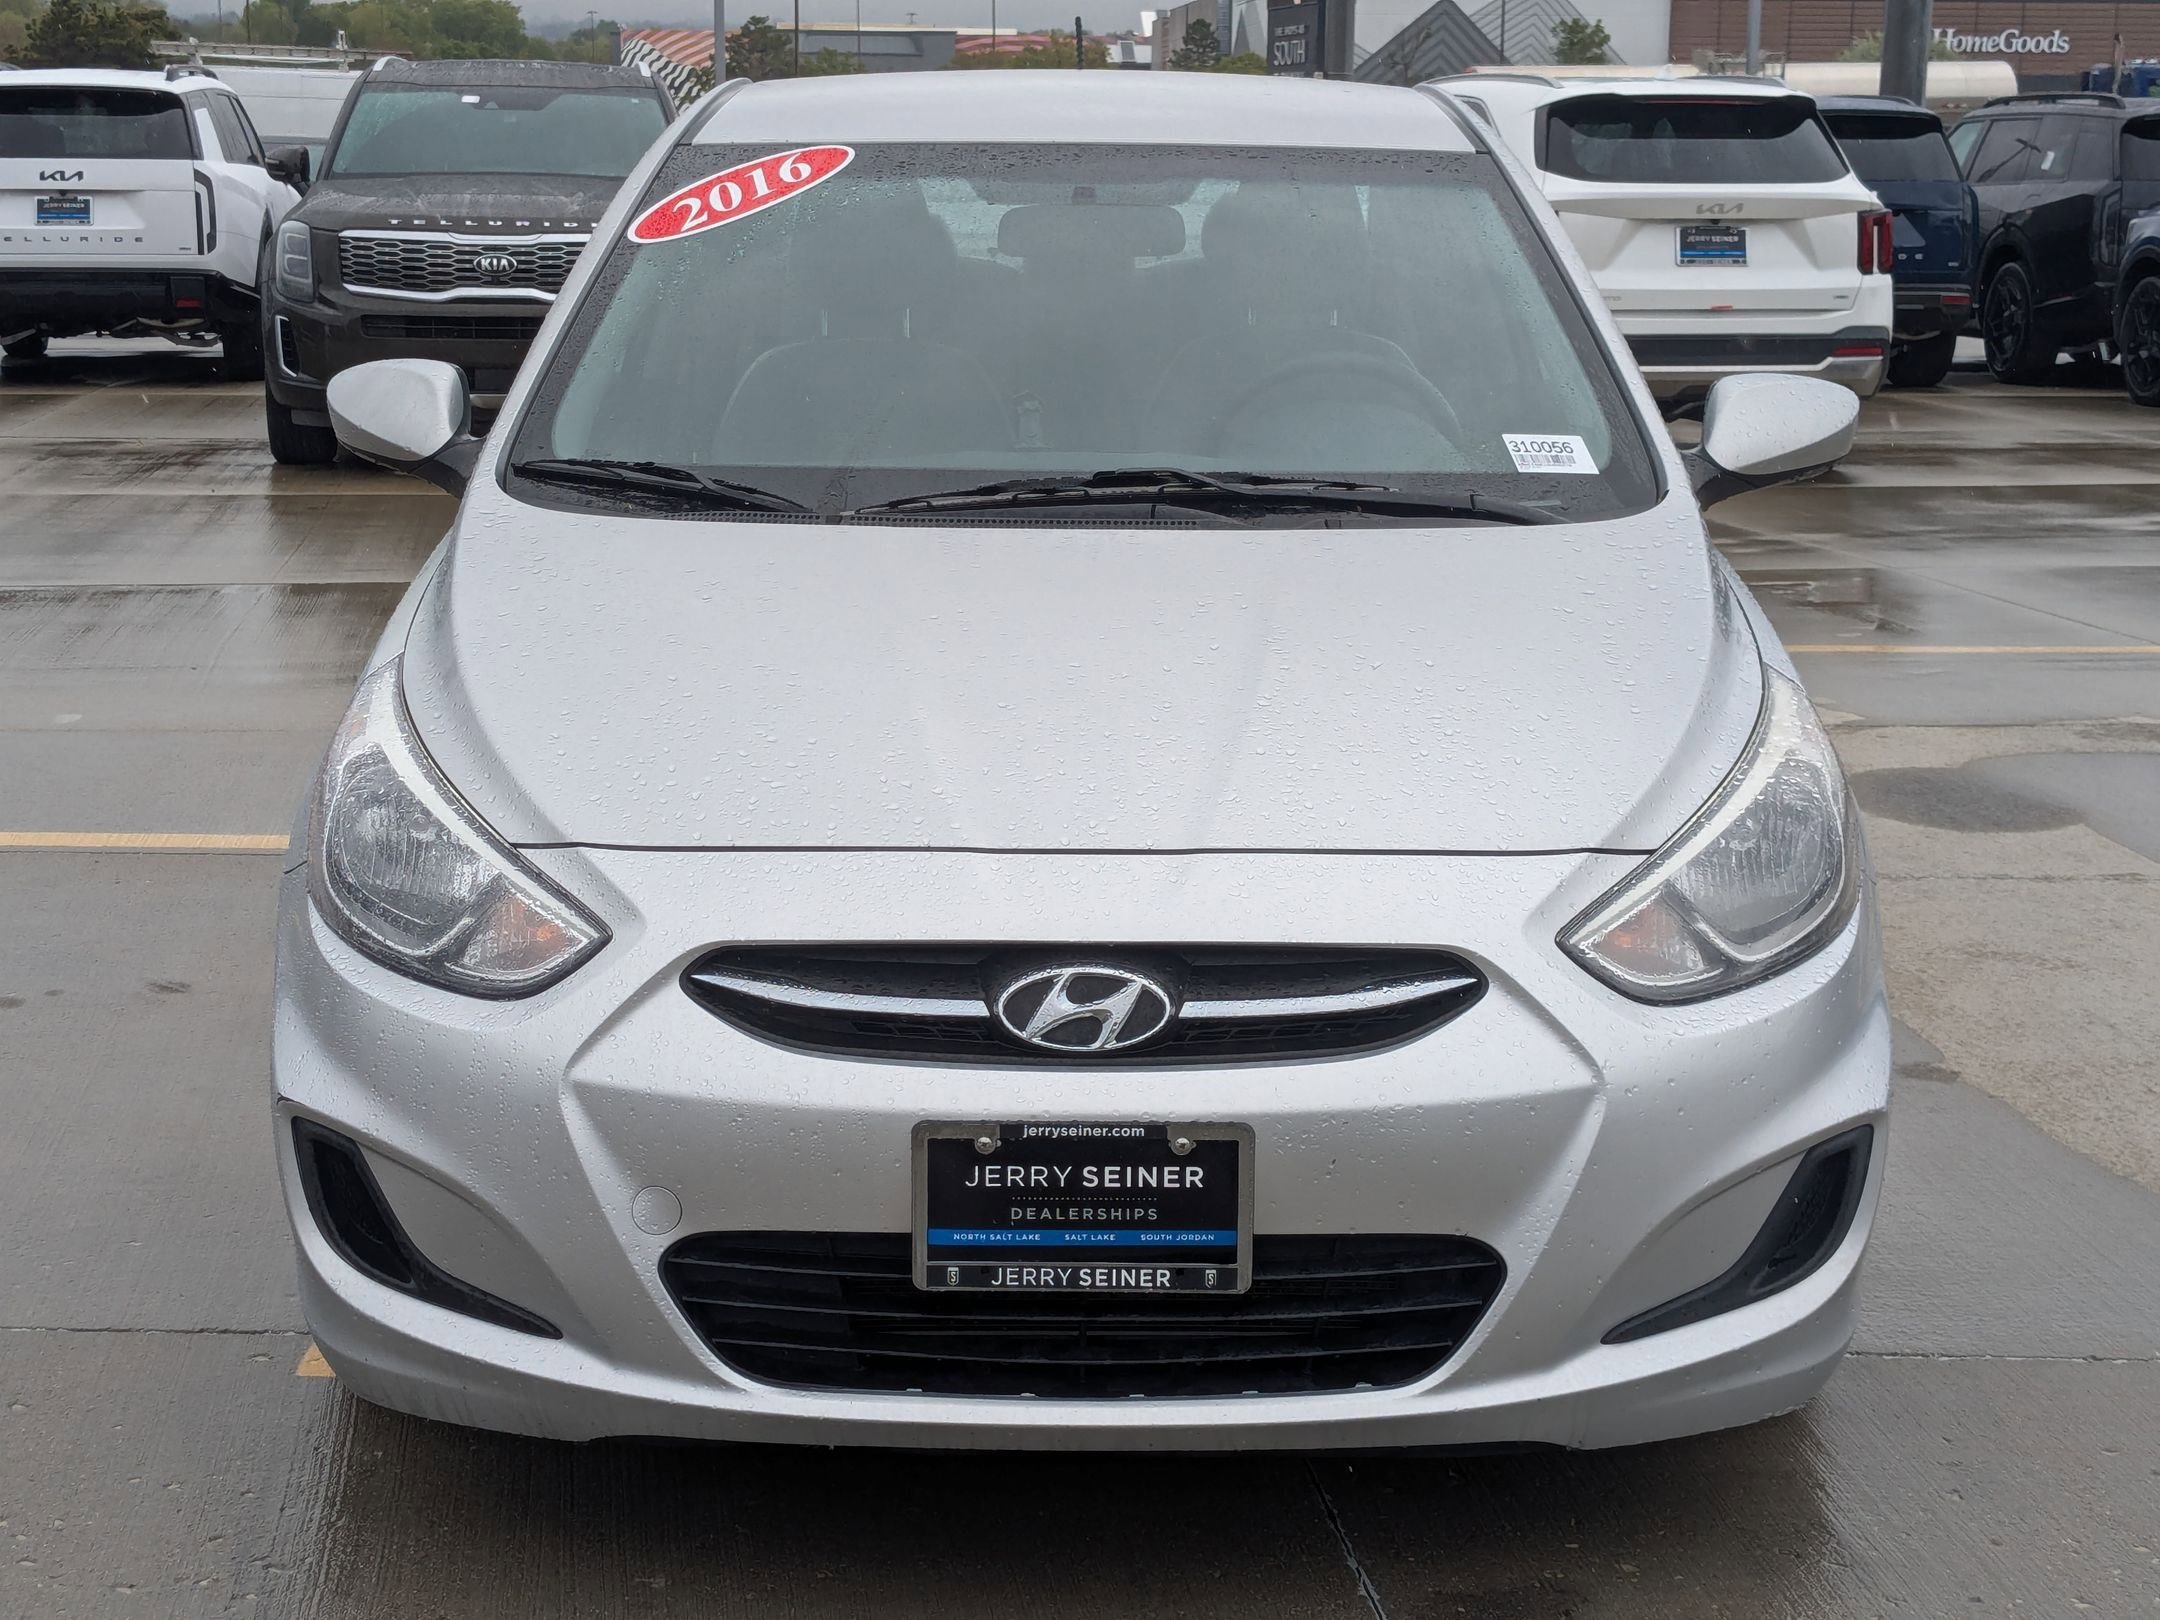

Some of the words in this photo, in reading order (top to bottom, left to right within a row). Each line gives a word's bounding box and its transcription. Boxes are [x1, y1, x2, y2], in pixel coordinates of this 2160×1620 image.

[1932, 27, 2070, 54] HomeGoods
[1273, 40, 1305, 65] SOUTH
[672, 152, 812, 232] 2016
[480, 257, 511, 271] KIA
[1508, 440, 1574, 454] 310056
[1023, 1124, 1145, 1139] jerryseiner.com
[965, 1165, 1072, 1187] JERRY
[1082, 1165, 1204, 1188] SEINER
[1011, 1207, 1158, 1221] DEALERSHIPS
[953, 1233, 986, 1241] NORTH
[989, 1233, 1012, 1241] SALT
[1016, 1233, 1041, 1241] LAKE
[1064, 1233, 1088, 1241] SALT
[1091, 1233, 1116, 1241] LAKE
[1140, 1233, 1172, 1241] SOUTH
[1176, 1233, 1215, 1241] JORDAN
[991, 1267, 1072, 1286] JERRY
[1079, 1268, 1171, 1287] SEINER
